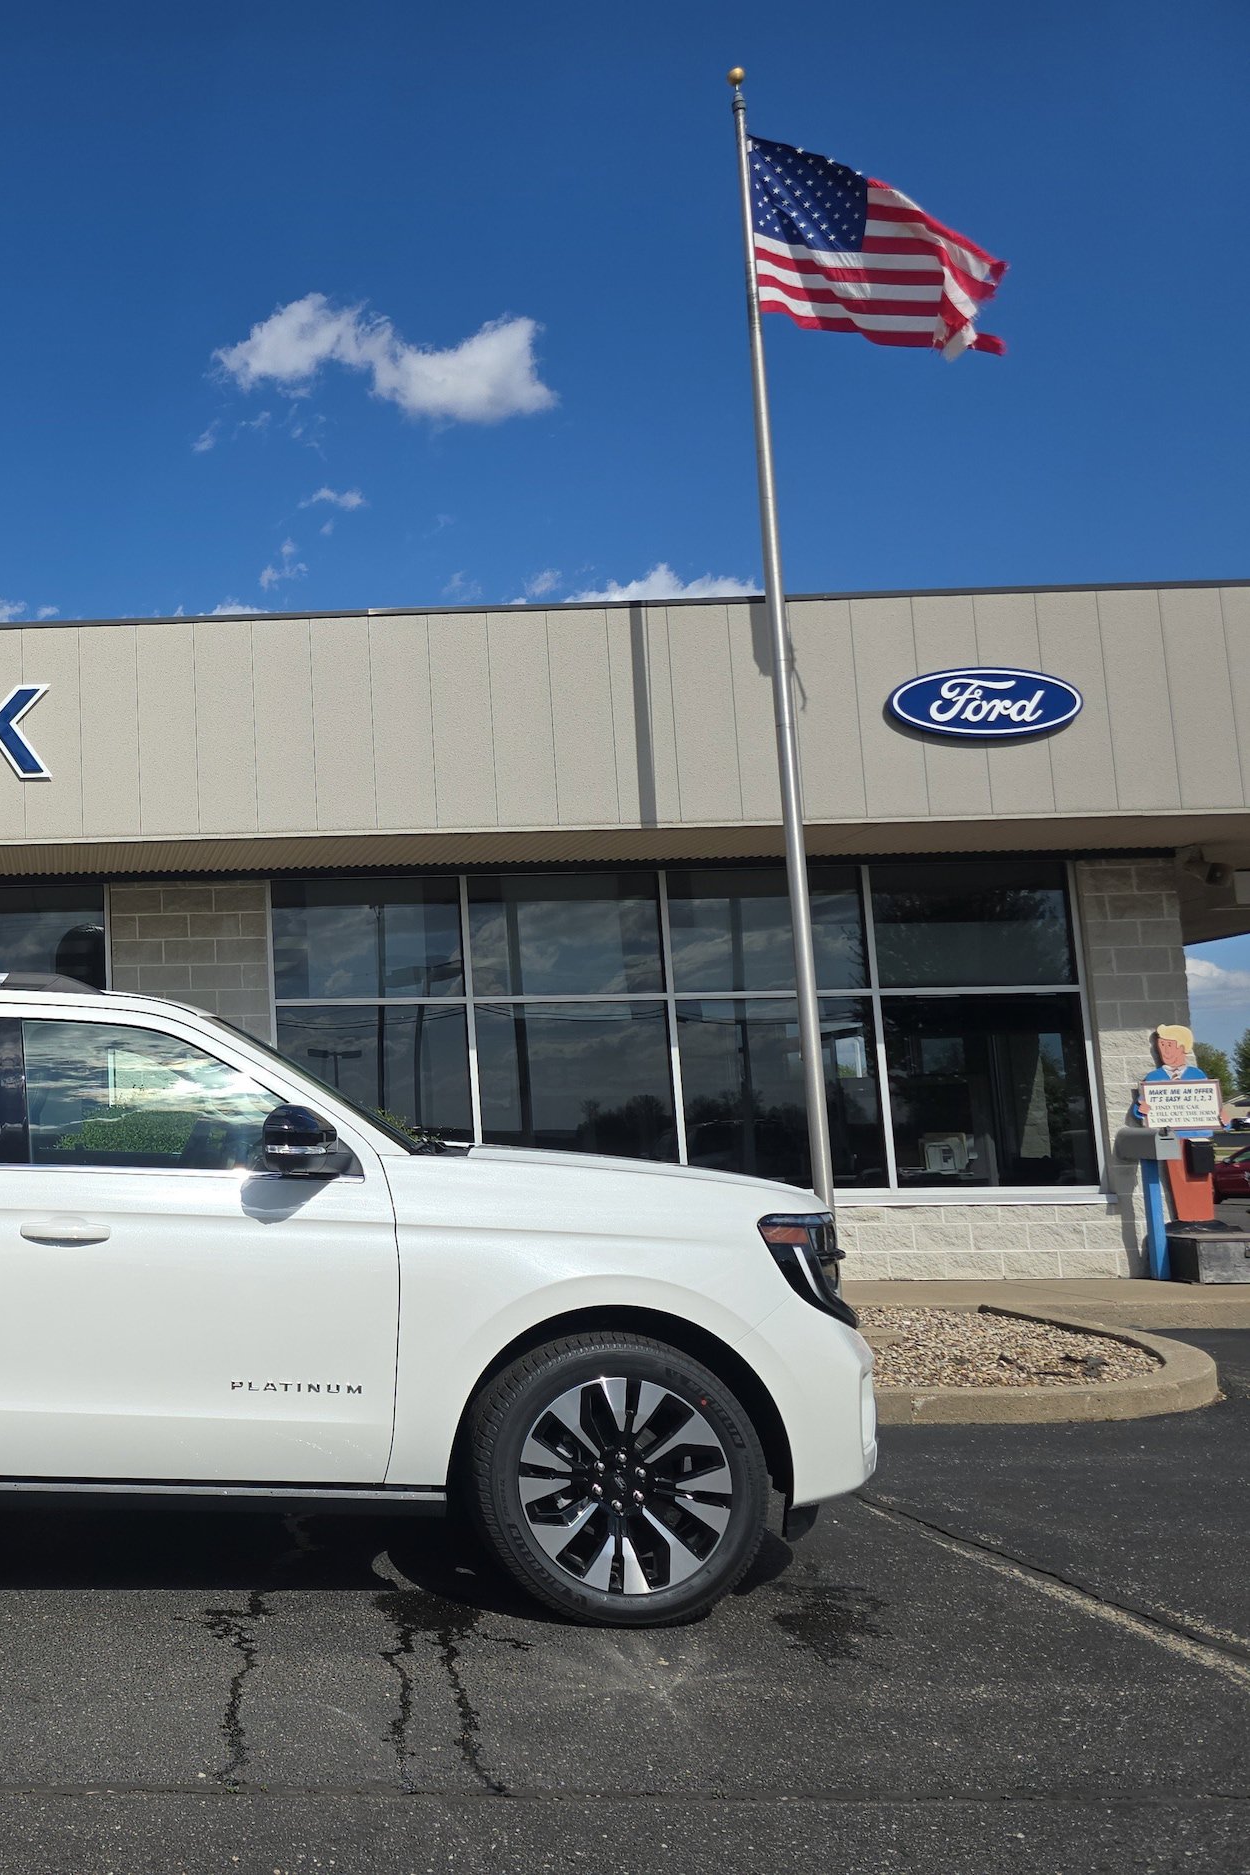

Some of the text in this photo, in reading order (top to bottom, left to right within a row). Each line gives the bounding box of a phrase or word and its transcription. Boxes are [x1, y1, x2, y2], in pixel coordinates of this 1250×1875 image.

[929, 678, 1045, 722] Ford
[230, 1380, 363, 1394] PLATINUM
[509, 1526, 567, 1593] MICHELIN
